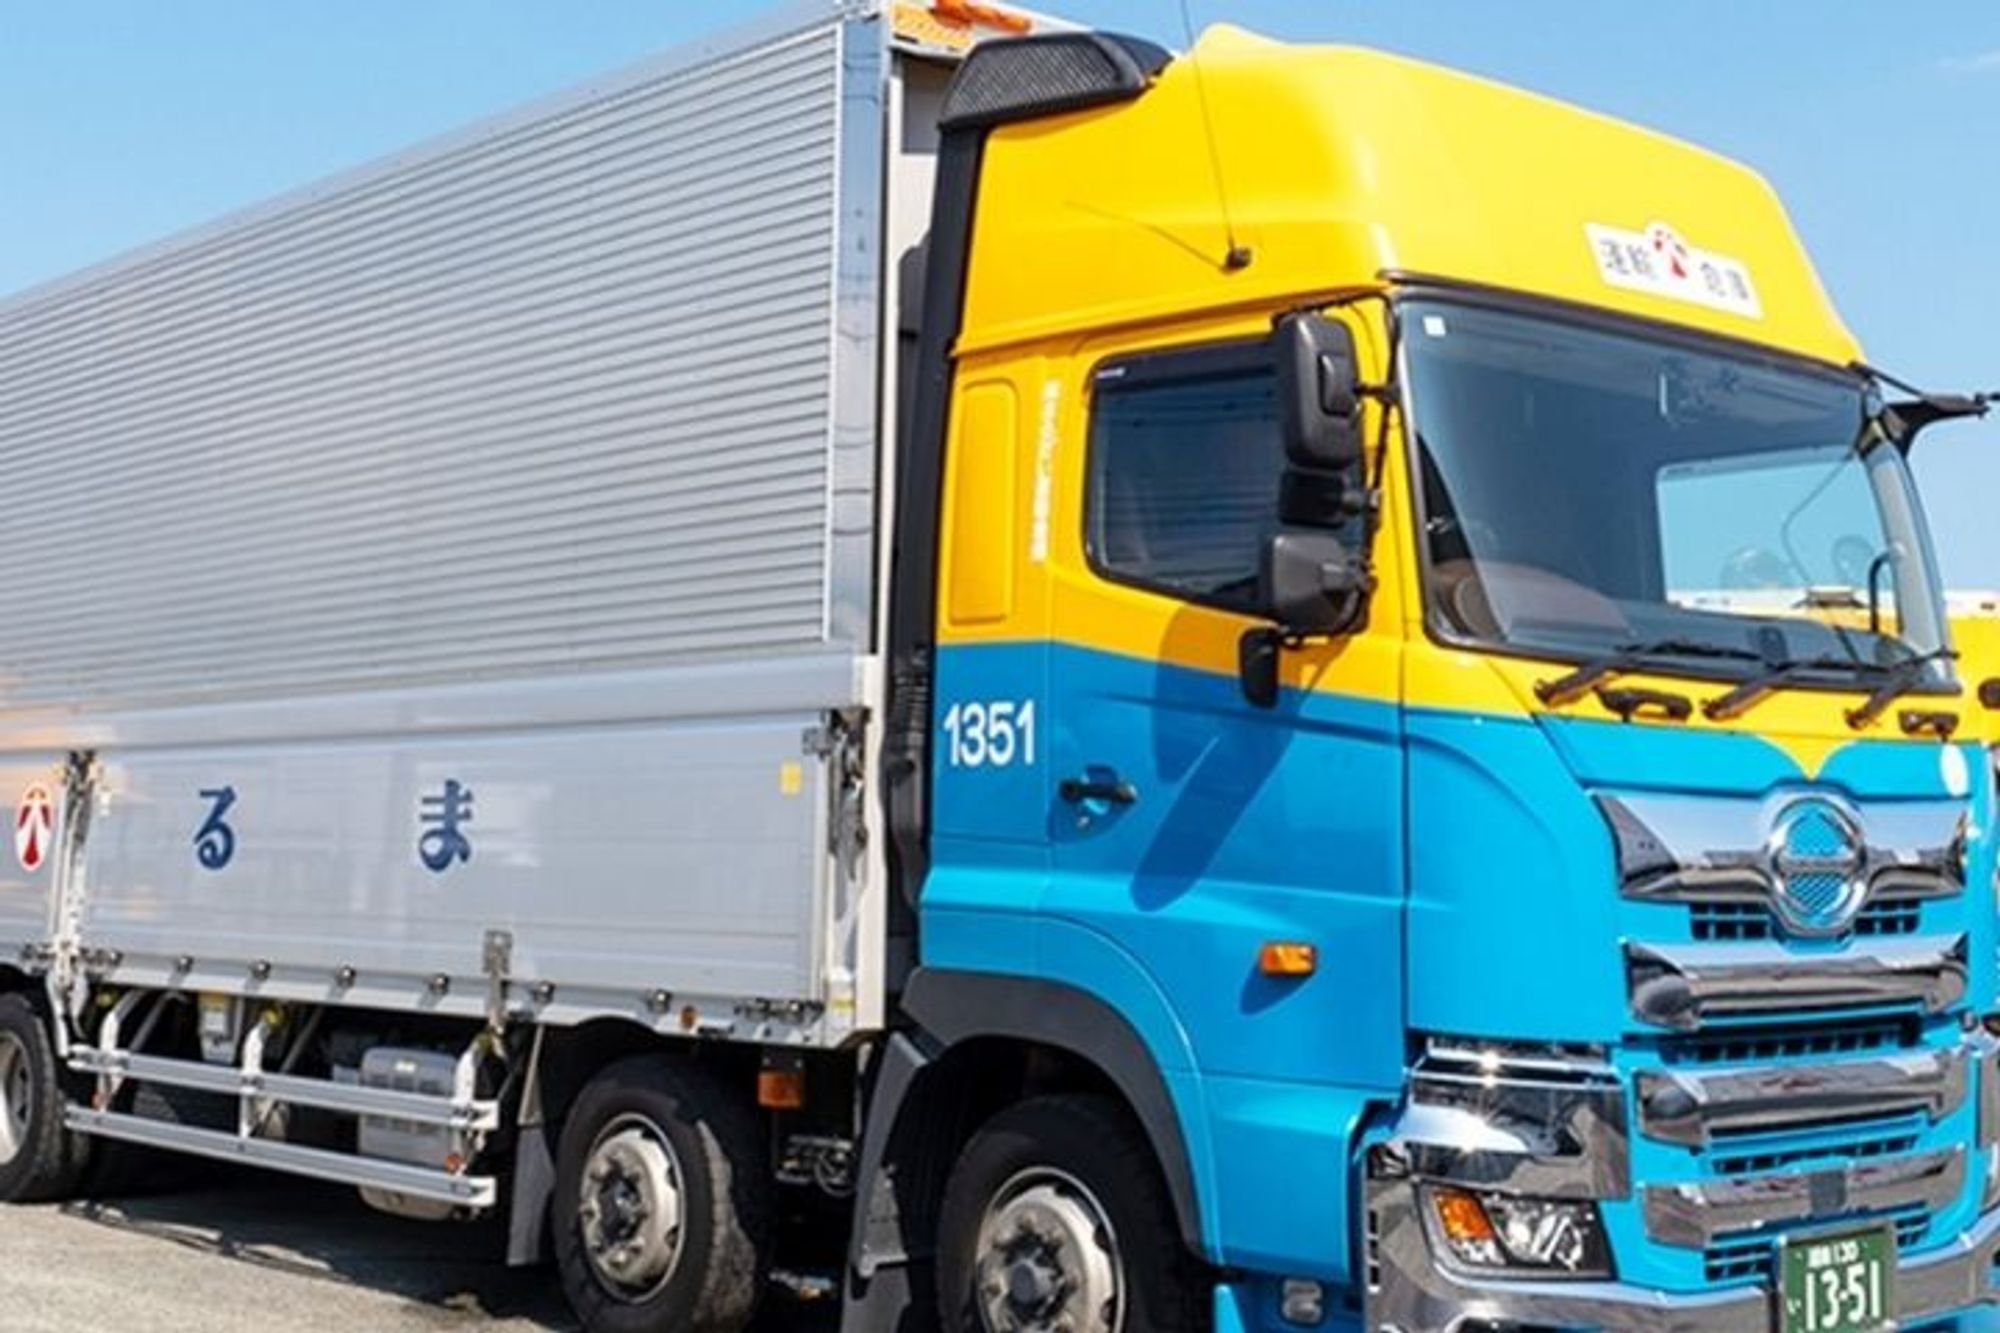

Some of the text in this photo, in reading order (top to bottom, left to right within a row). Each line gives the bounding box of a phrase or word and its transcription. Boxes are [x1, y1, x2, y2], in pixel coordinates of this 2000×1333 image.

[943, 699, 1035, 767] 1351
[194, 778, 474, 872] る ま
[1805, 1259, 1881, 1332] 13-51
